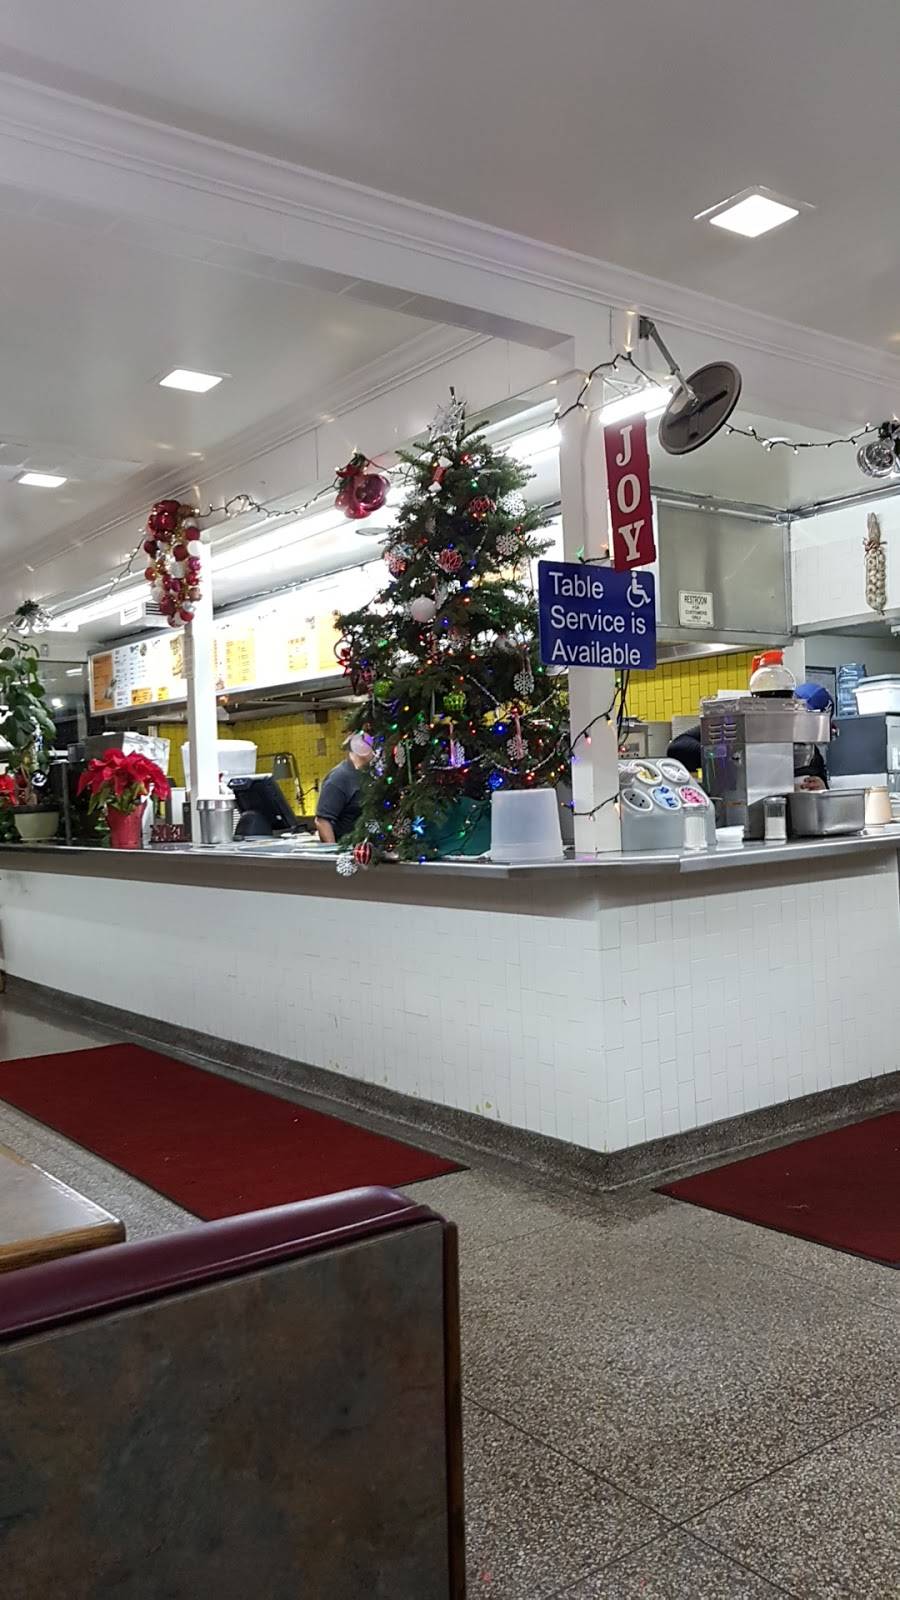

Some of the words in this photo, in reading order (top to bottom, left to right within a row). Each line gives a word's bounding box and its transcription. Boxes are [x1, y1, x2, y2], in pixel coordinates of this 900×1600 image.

[615, 424, 645, 562] JOY
[548, 571, 604, 599] Table
[550, 604, 625, 633] Service
[631, 611, 646, 635] is
[551, 638, 641, 666] Available
